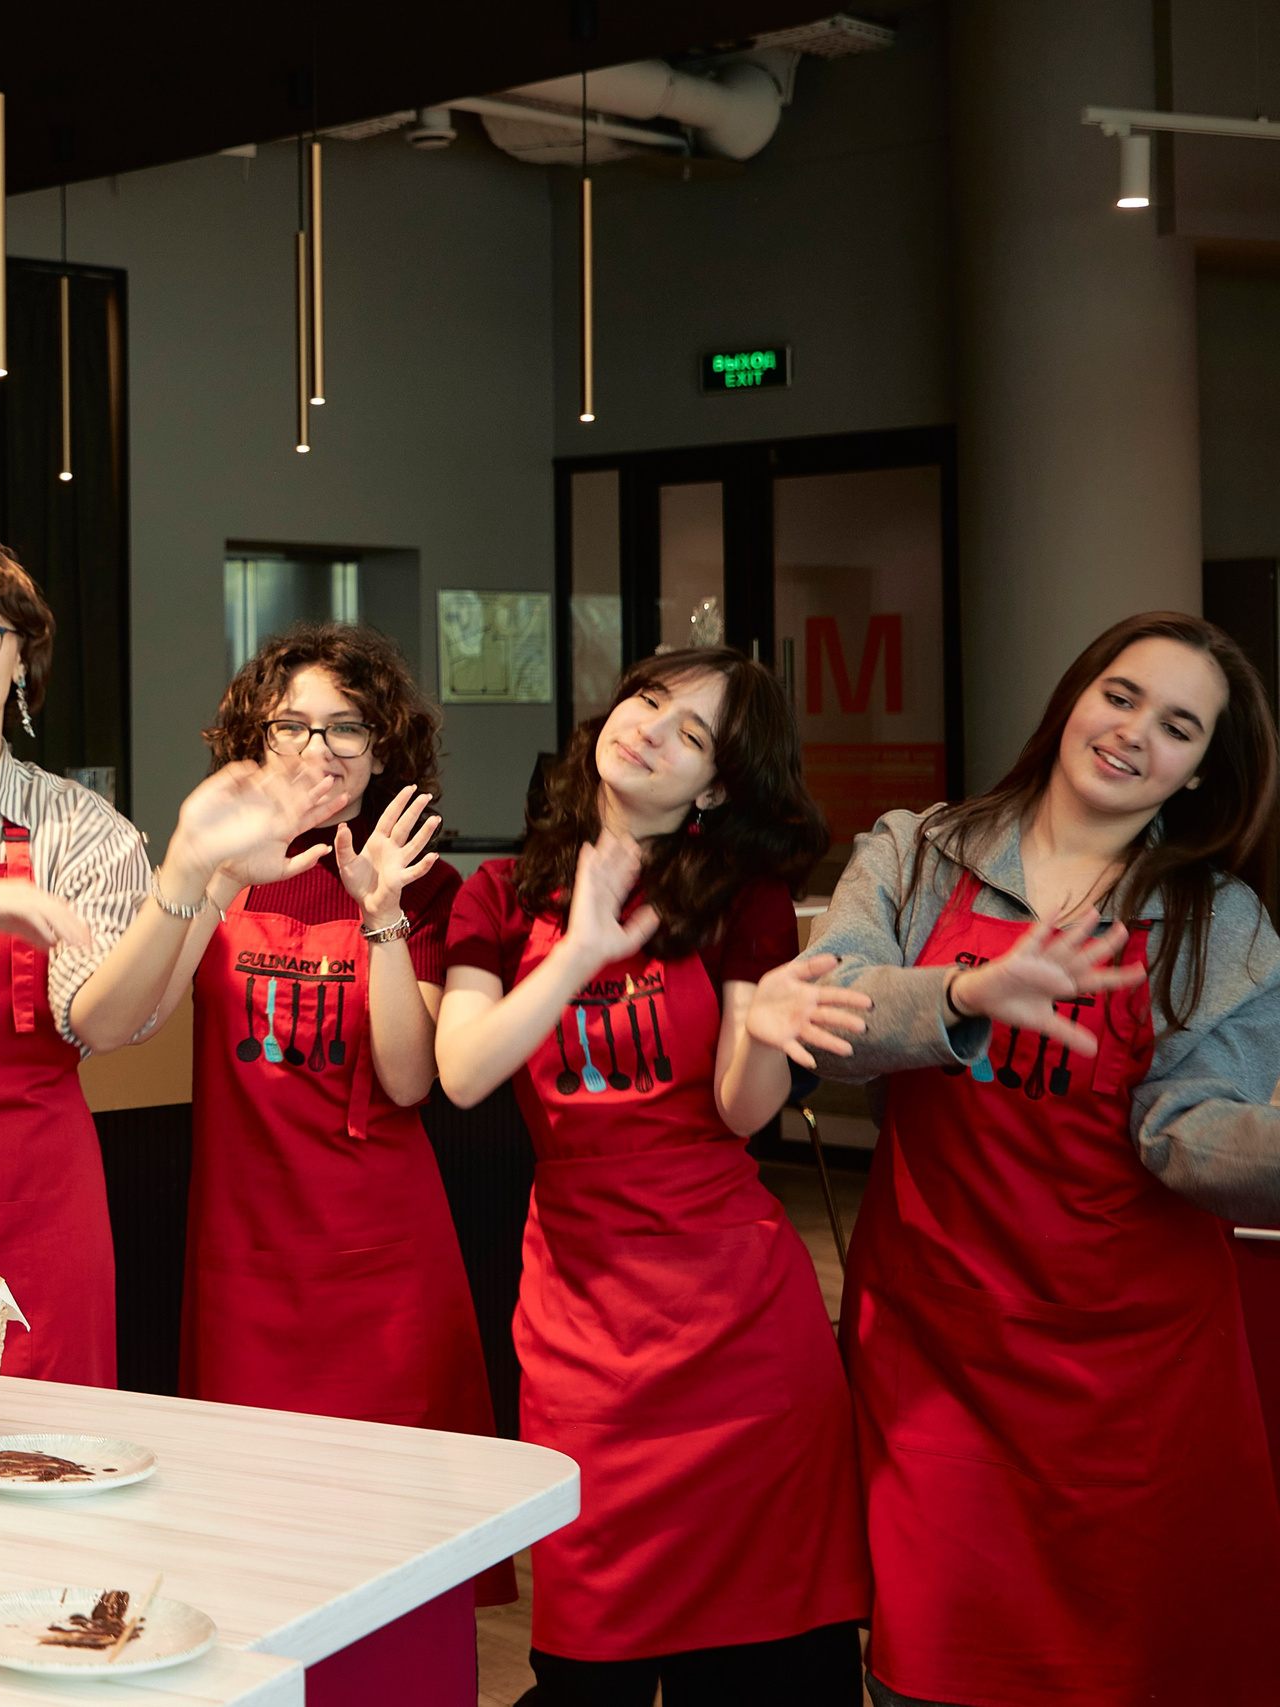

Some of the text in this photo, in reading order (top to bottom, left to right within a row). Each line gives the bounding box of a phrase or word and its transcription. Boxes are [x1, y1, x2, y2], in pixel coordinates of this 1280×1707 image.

[712, 351, 777, 373] ВЫХОД
[725, 369, 765, 388] EXIT
[237, 950, 356, 974] CULINARY ON
[577, 971, 662, 997] NARY ON
